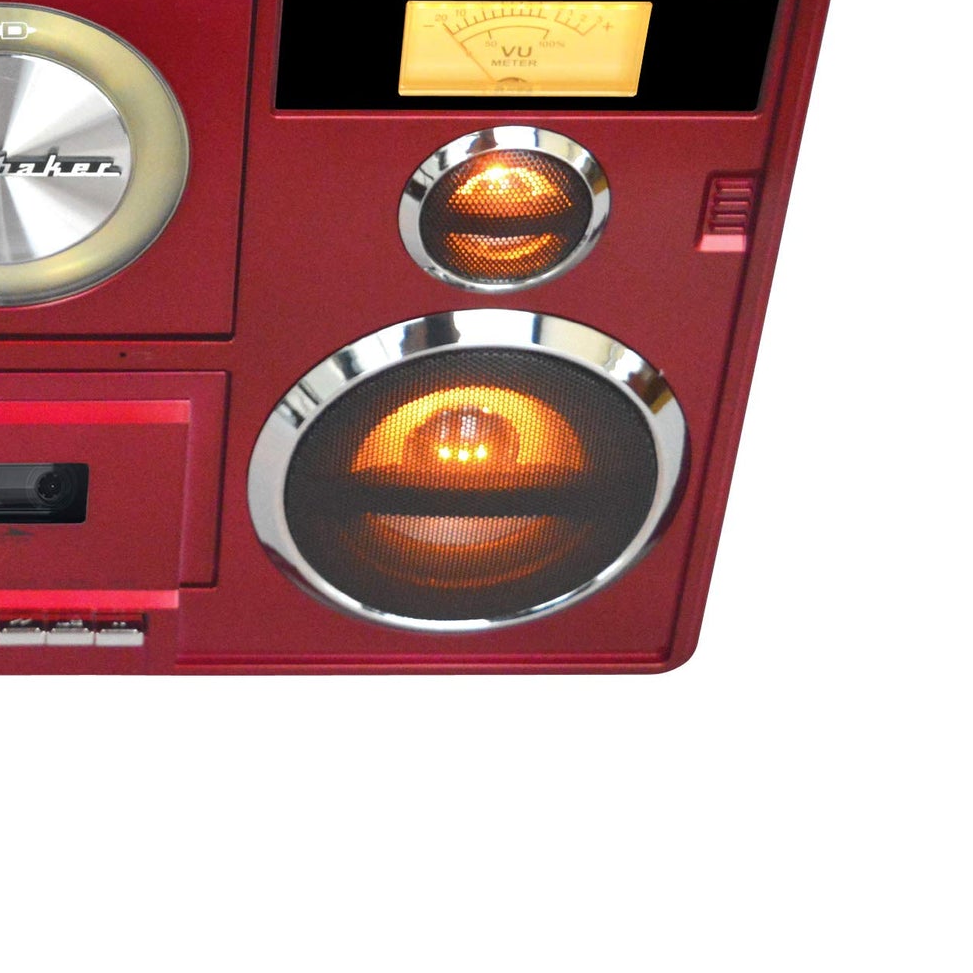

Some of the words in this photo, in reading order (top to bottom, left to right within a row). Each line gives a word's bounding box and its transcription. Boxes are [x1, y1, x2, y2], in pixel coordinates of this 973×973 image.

[434, 13, 448, 22] 20
[455, 9, 466, 17] 10
[484, 40, 498, 48] 50
[501, 46, 533, 58] VU
[491, 59, 537, 67] METER
